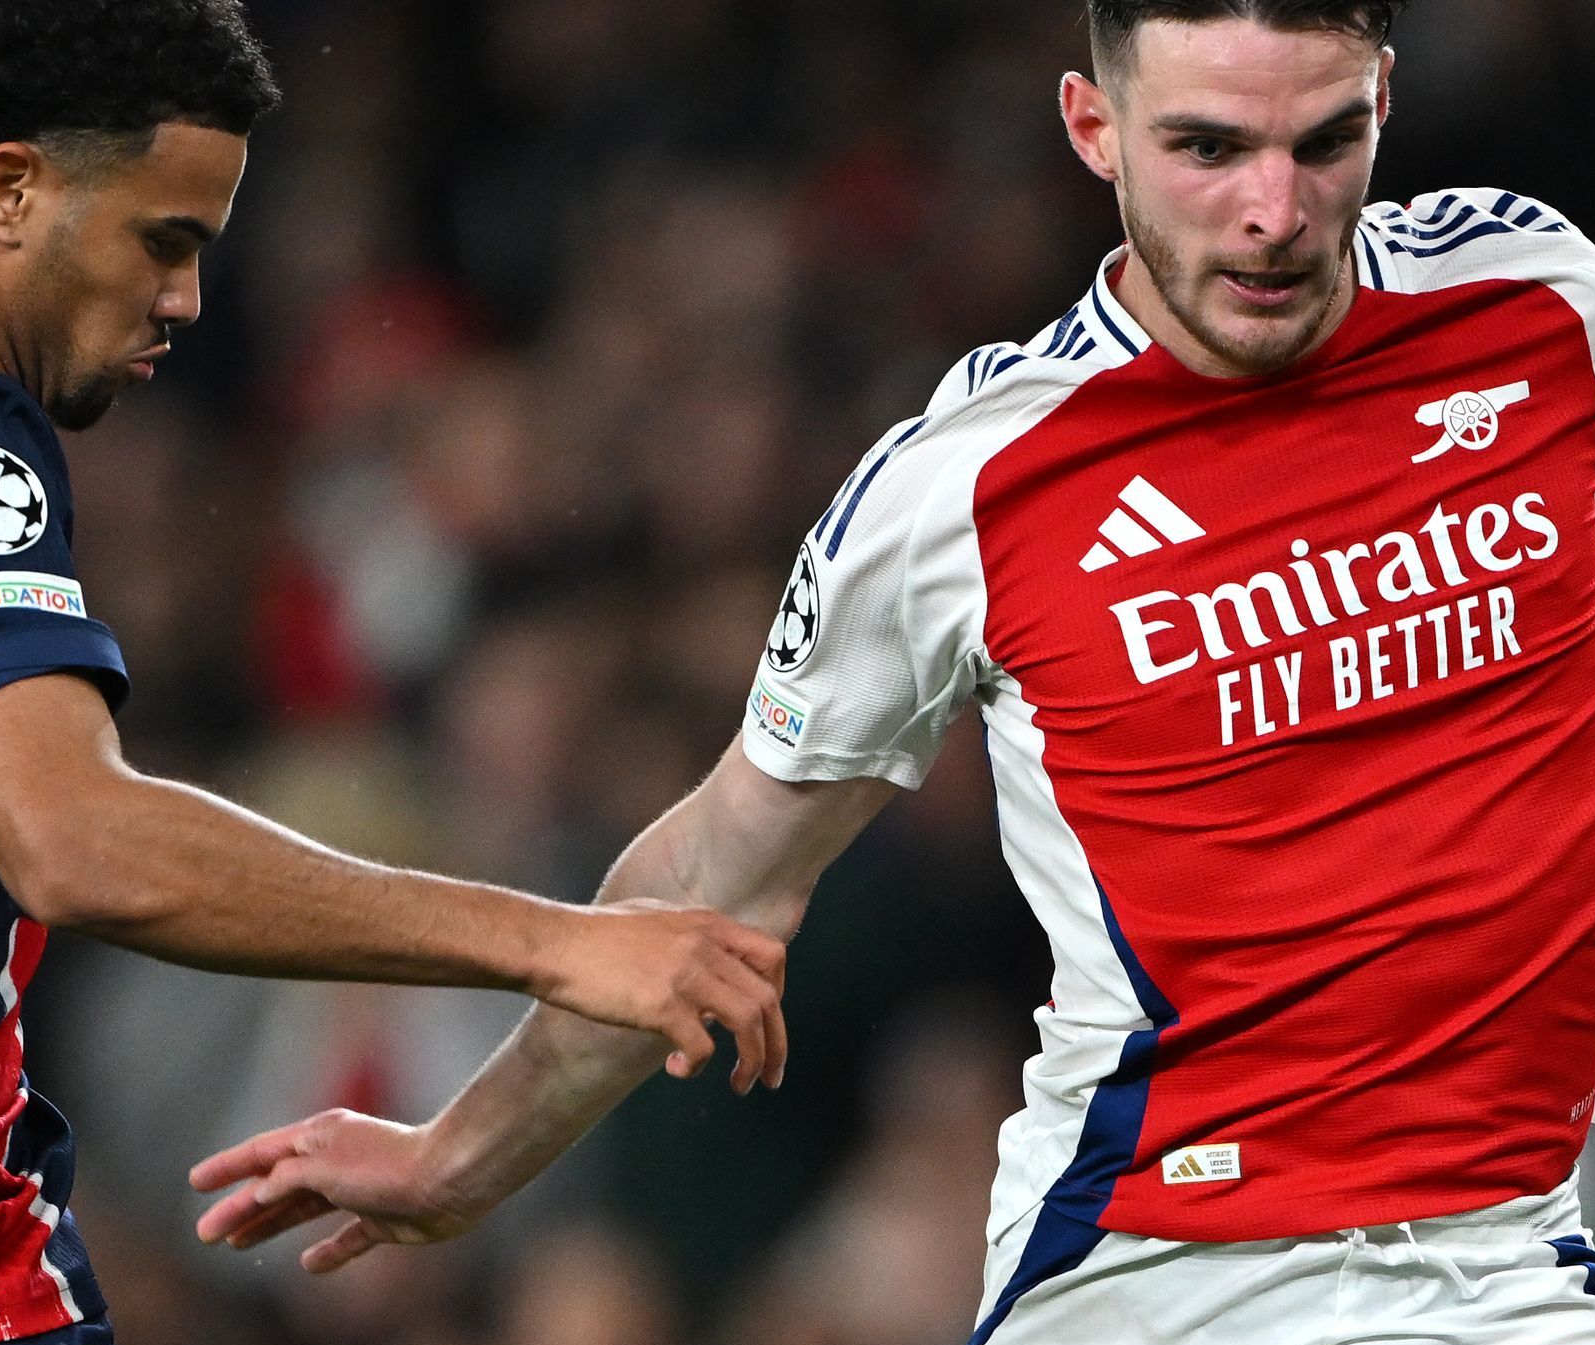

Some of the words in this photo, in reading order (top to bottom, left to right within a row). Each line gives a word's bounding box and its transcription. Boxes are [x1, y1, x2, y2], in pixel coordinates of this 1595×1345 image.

[1108, 492, 1559, 685] Emirates
[1217, 650, 1305, 746] FLY
[1328, 587, 1523, 711] BETTER
